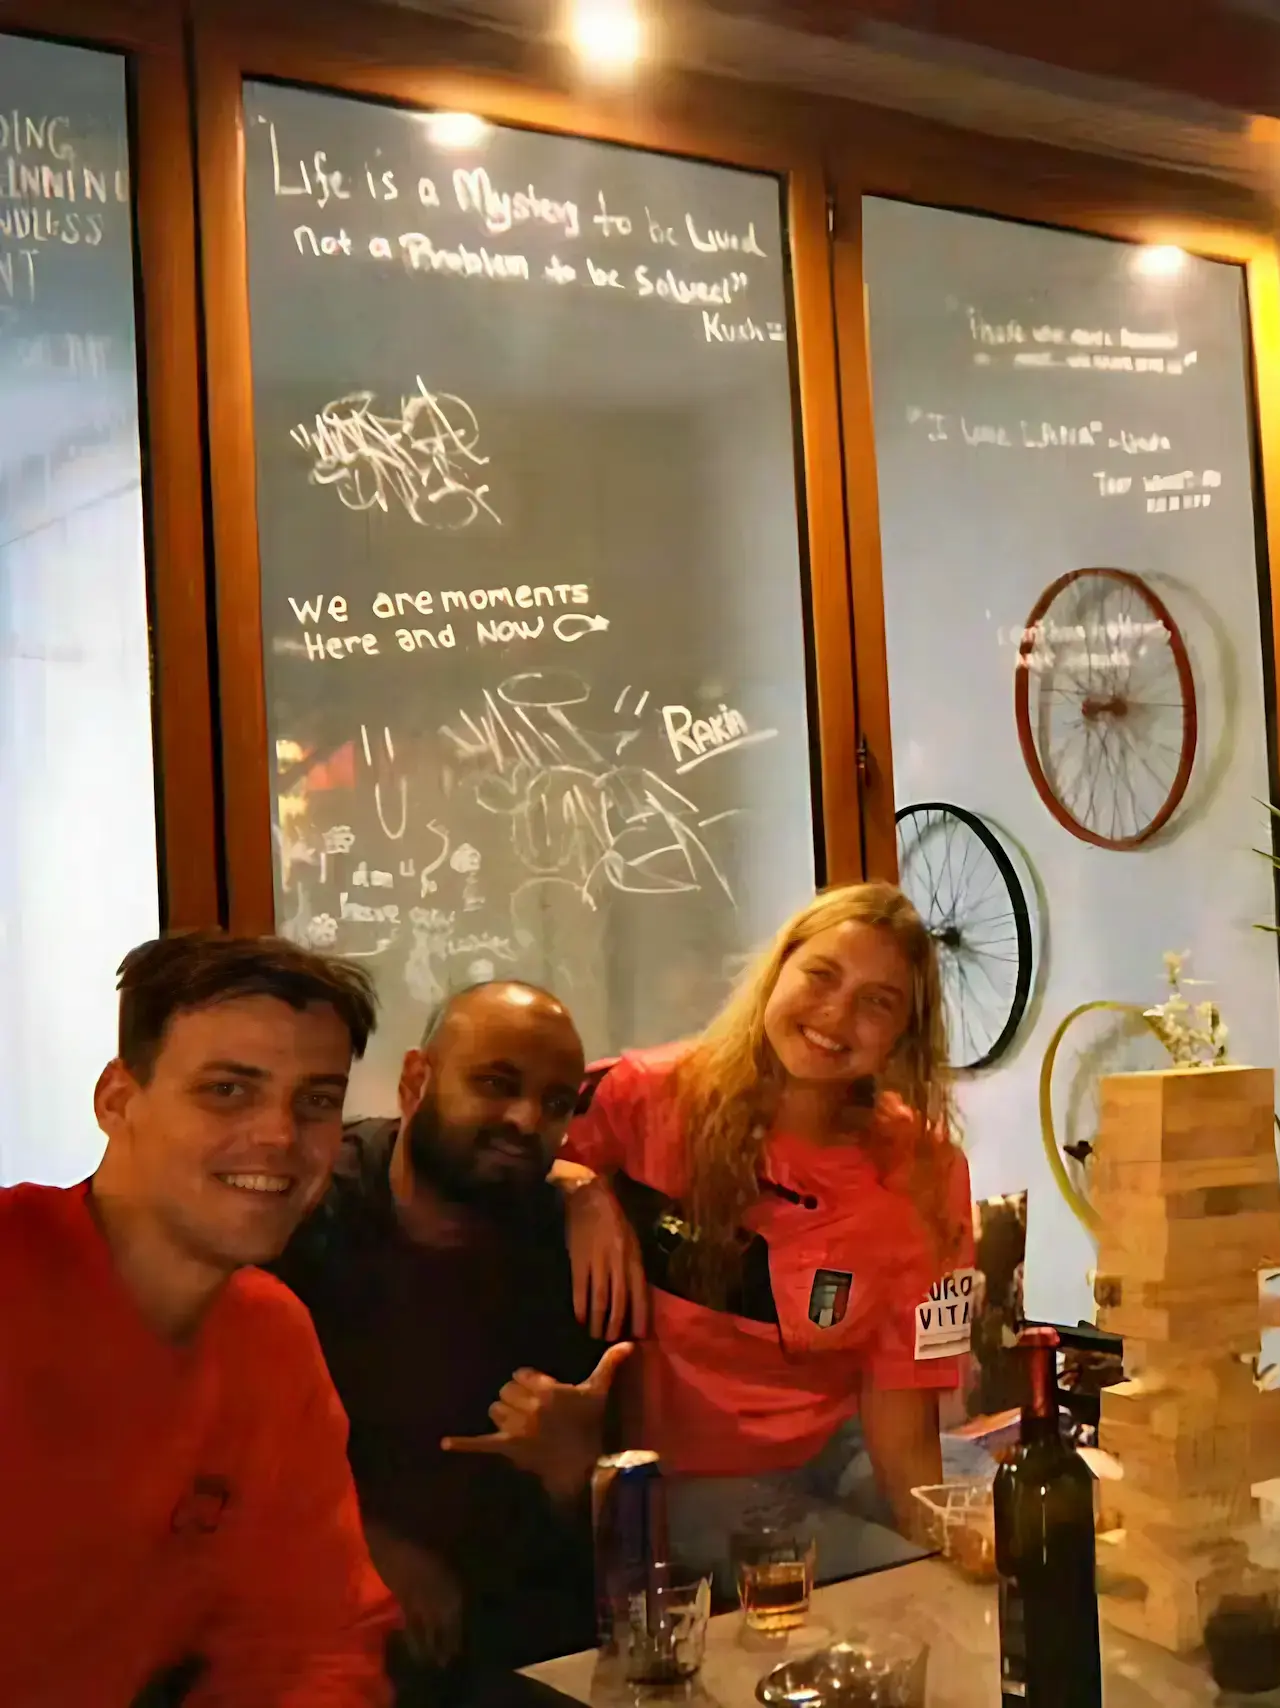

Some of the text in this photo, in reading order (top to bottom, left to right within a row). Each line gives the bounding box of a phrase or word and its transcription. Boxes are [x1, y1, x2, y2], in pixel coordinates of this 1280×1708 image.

[364, 147, 398, 201] is
[418, 177, 440, 207] a
[593, 189, 632, 238] to
[645, 205, 679, 246] be
[368, 237, 392, 260] a
[586, 257, 625, 289] be
[288, 594, 348, 624] We
[371, 590, 434, 619] are
[303, 630, 380, 662] Here
[395, 623, 456, 652] and
